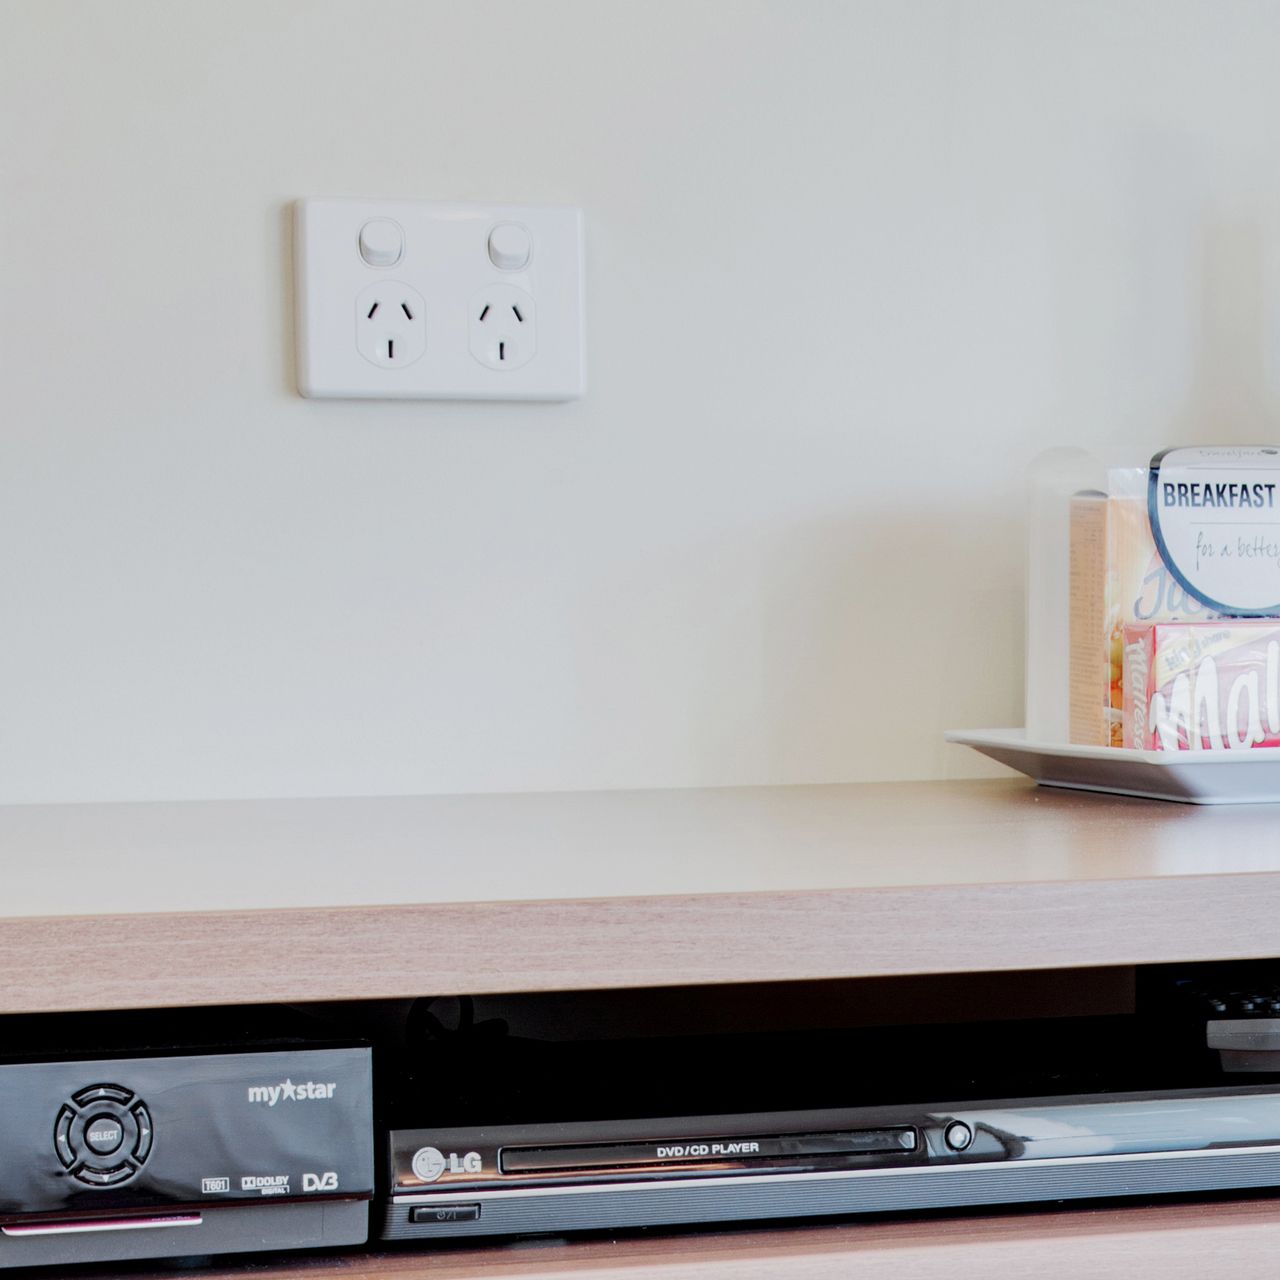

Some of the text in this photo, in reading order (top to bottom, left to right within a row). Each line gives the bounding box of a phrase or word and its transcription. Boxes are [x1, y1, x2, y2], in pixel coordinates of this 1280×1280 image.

[1163, 483, 1275, 508] BREAKFAST
[1238, 535, 1280, 558] better
[89, 1130, 118, 1141] SELECT
[656, 1142, 760, 1158] DVD/CD PLAYER
[449, 1152, 482, 1173] LG
[257, 1176, 289, 1187] DOLBY
